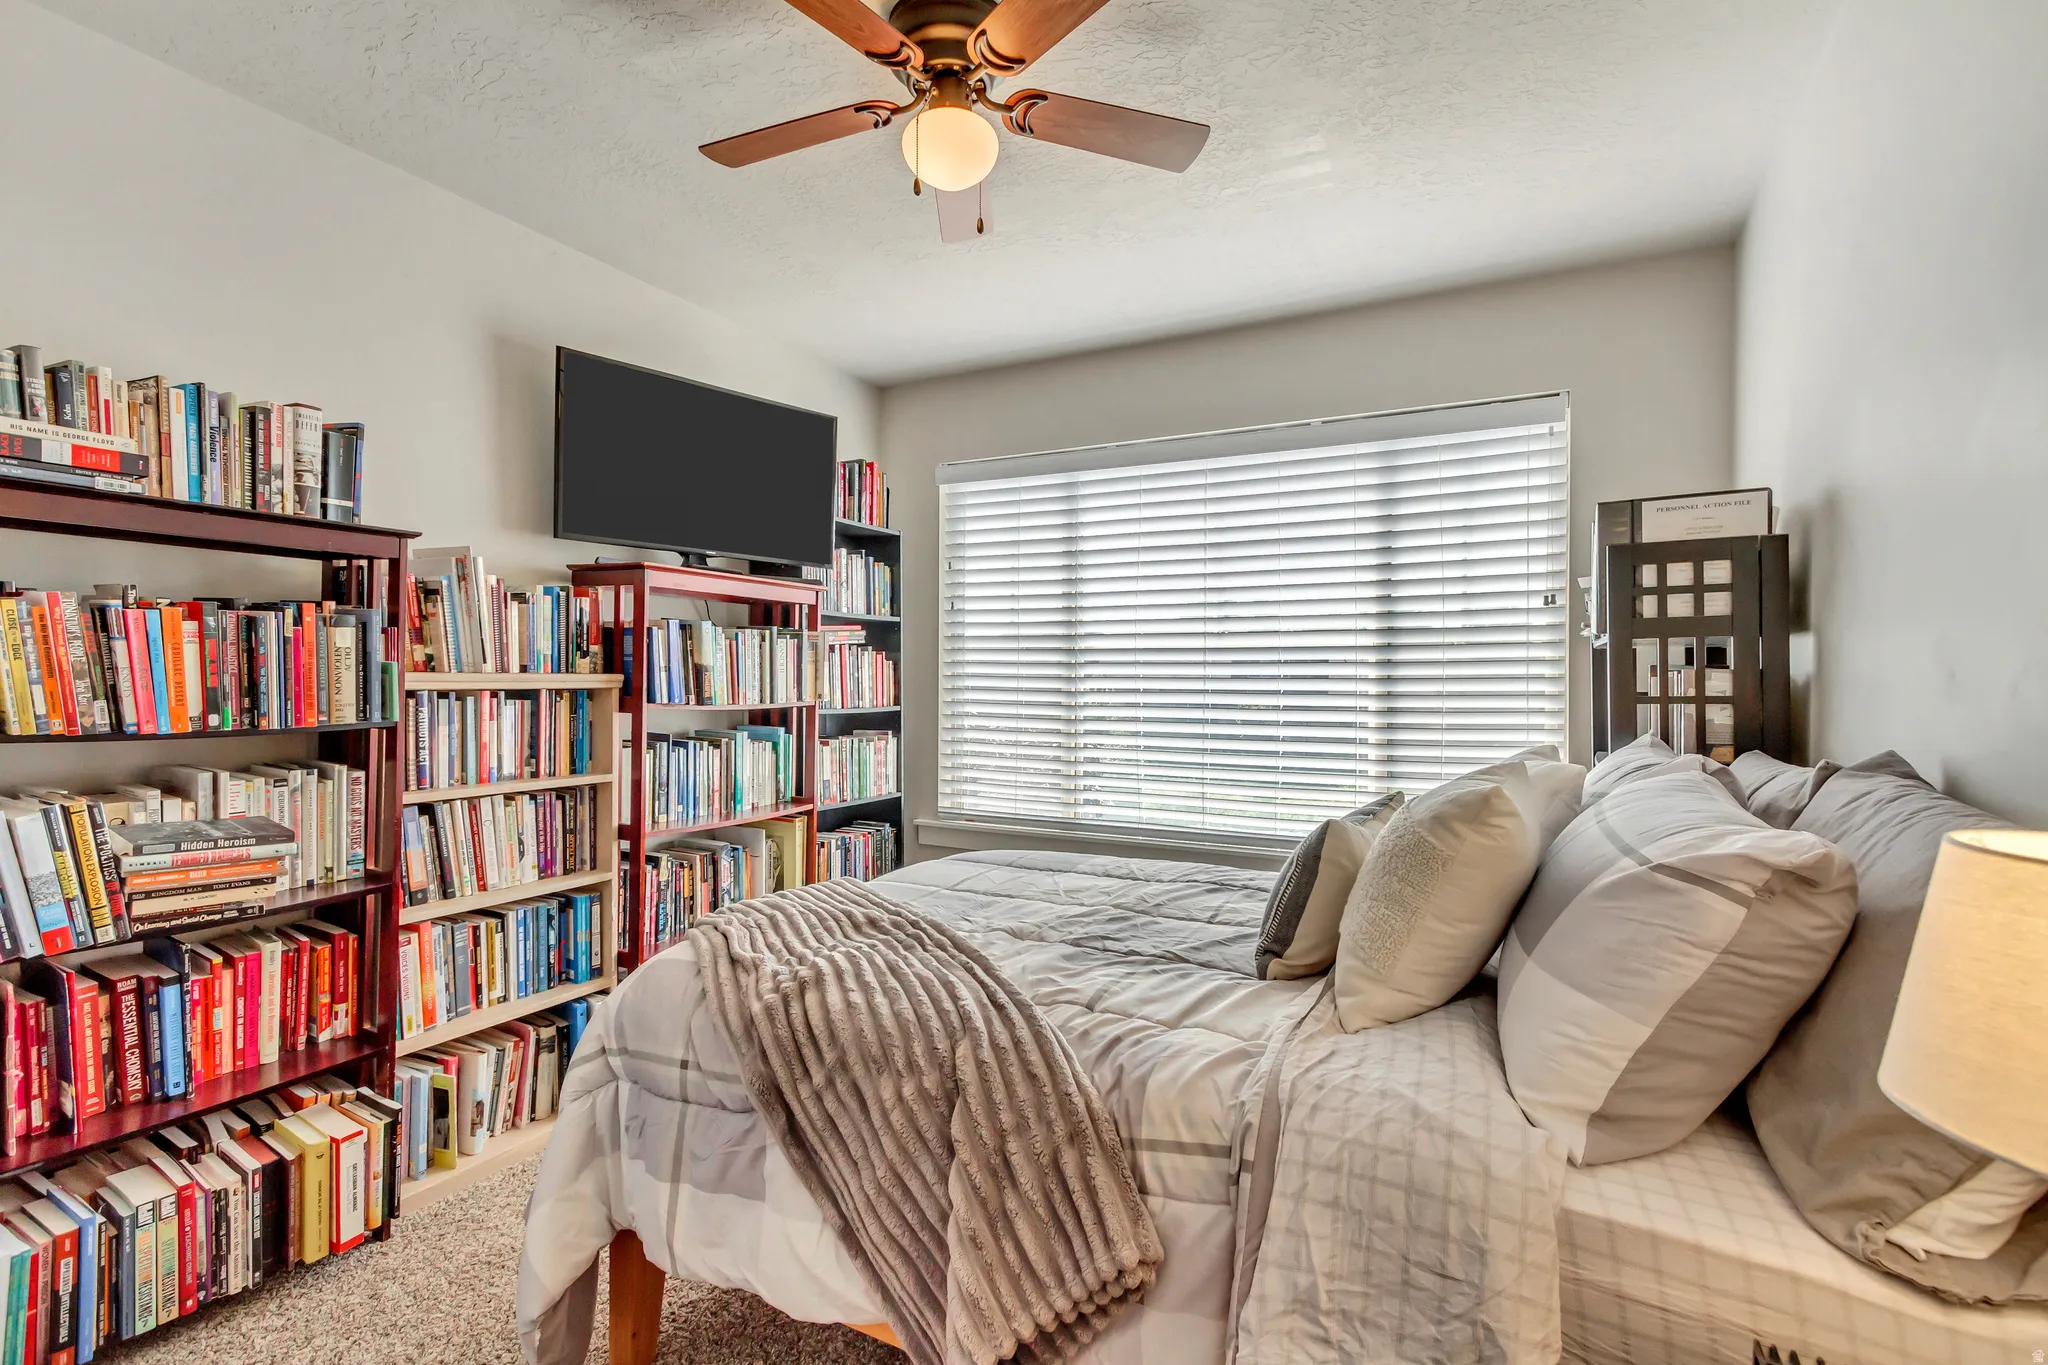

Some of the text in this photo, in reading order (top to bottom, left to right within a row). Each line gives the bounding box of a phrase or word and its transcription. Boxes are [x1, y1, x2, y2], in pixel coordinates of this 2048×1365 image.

[27, 426, 48, 435] NAME
[63, 433, 89, 442] GEORGE
[93, 437, 114, 446] FLOYD
[209, 426, 219, 462] Violence
[6, 609, 23, 661] CLOSE EDGE
[228, 614, 236, 643] CRIMINAL
[39, 624, 47, 633] Hip
[44, 647, 54, 678] Generation
[69, 640, 86, 662] PEOPLE
[171, 643, 182, 676] CADILLAC
[228, 646, 237, 673] INJUSTICE
[334, 641, 342, 695] NONVIOLEN
[344, 647, 352, 672] ACTIO
[175, 682, 185, 707] DESERT
[418, 707, 429, 765] PATRIOTS ACT
[350, 777, 364, 850] NO GODS NO MASTERS
[75, 813, 105, 906] POPULATION EXPLOSION
[181, 837, 256, 851] Hidden Heroism
[55, 851, 73, 899] ANARCHIST
[96, 827, 125, 916] THE POLITICS OF PUNK
[152, 888, 186, 897] KINGDOM
[144, 921, 170, 929] Learning
[182, 915, 199, 925] Social
[200, 913, 222, 922] Change
[122, 1000, 142, 1091] ESSENTIAL CHOMSKY
[41, 1246, 49, 1272] WOMEN
[59, 1294, 71, 1343] INTELLECTUALS
